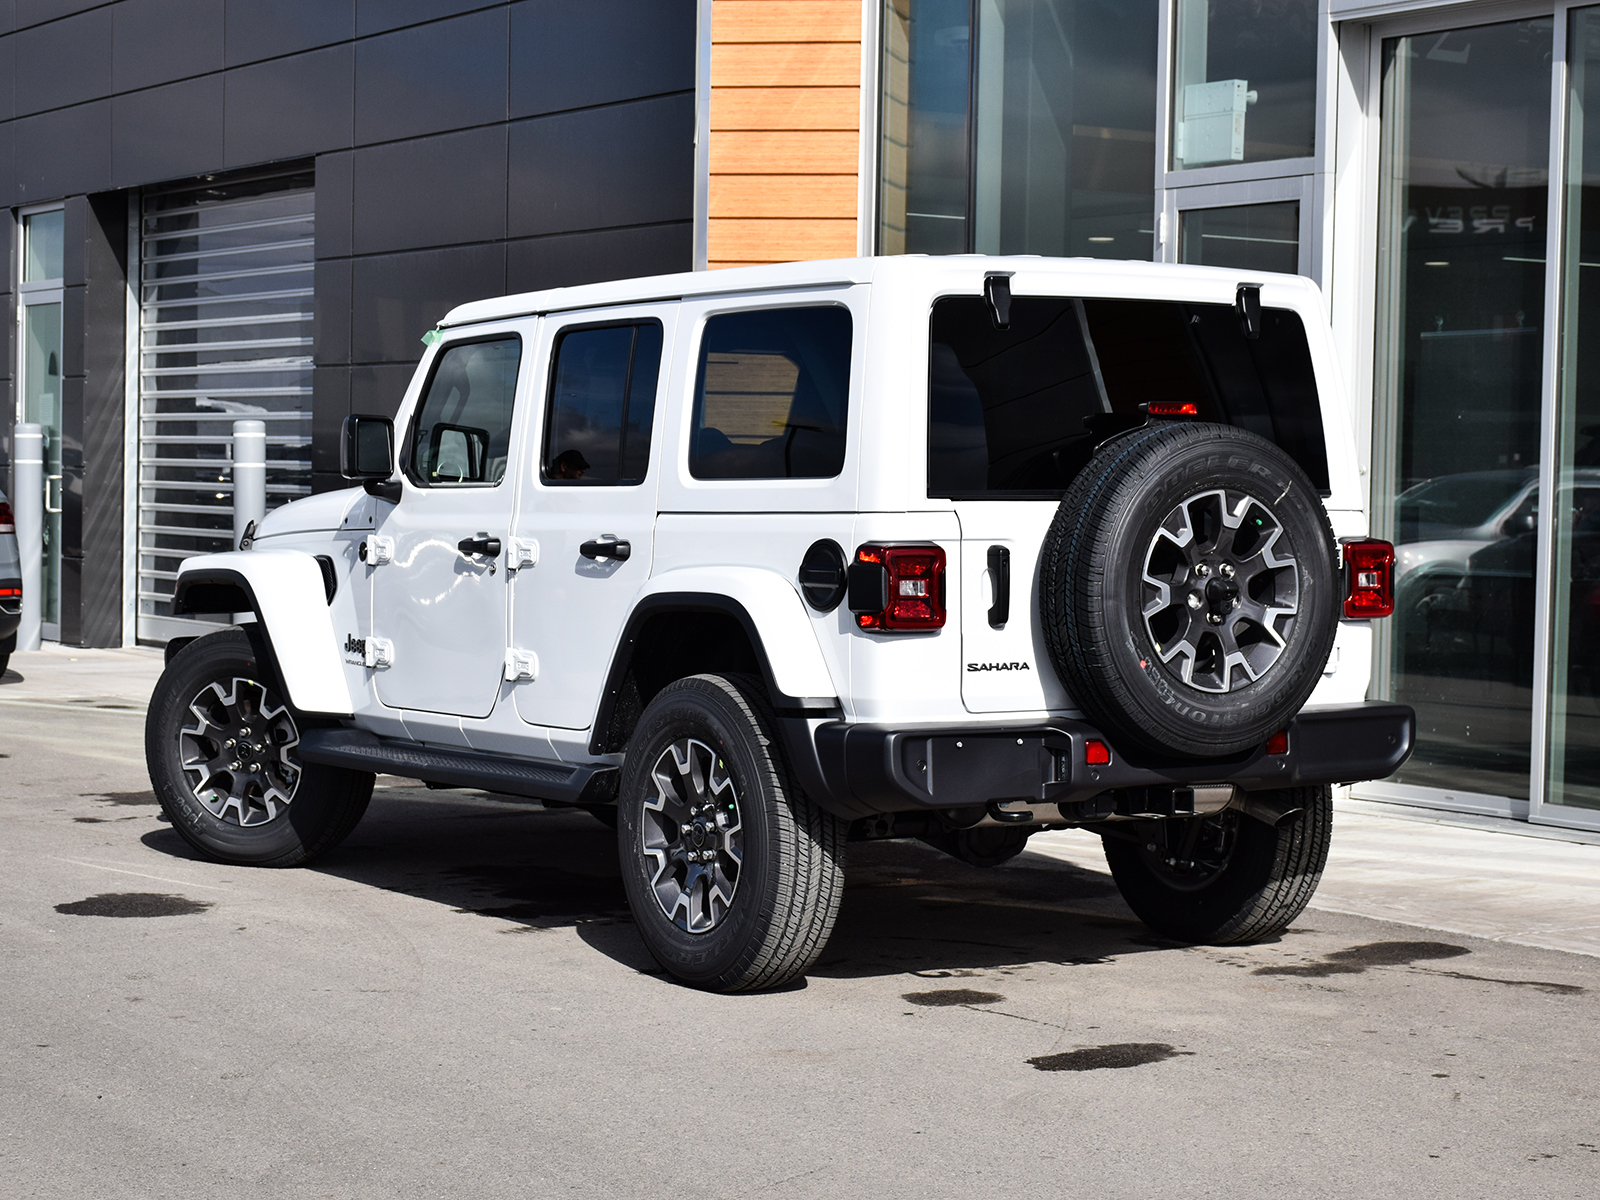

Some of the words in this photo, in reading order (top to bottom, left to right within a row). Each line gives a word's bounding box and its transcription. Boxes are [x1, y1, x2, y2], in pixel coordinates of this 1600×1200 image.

[1144, 454, 1274, 514] DUELER
[967, 662, 1030, 672] SAHARA
[1157, 636, 1321, 728] BRIDGESTONE
